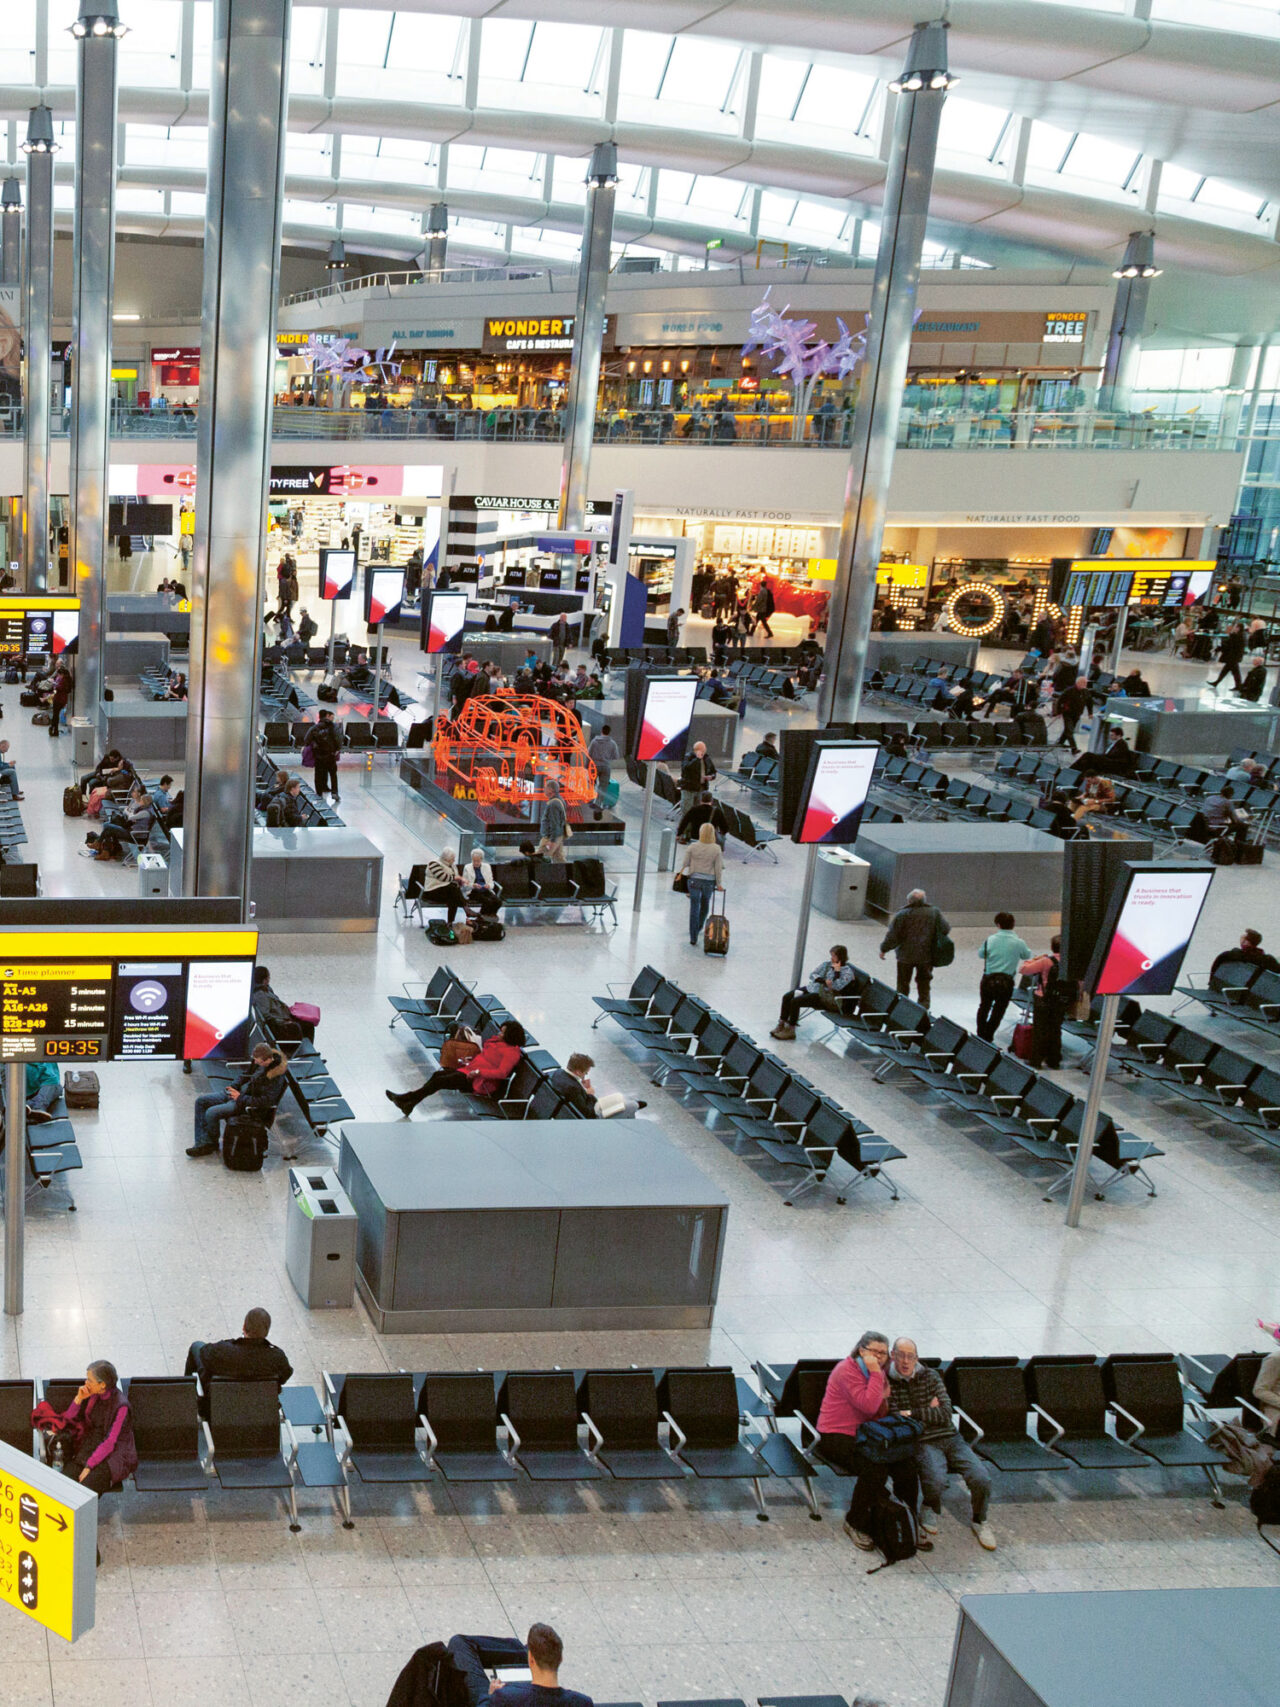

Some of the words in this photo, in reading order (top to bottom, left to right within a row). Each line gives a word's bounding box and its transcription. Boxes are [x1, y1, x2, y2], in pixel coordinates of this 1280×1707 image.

[1047, 312, 1087, 321] WONDER
[489, 318, 609, 337] WONDERTE
[1045, 322, 1084, 335] TREE
[474, 496, 509, 508] CAVIAR
[510, 498, 543, 510] HOUSE
[543, 499, 552, 510] &
[676, 508, 732, 518] NATURALLY
[736, 510, 759, 519] FAST
[762, 511, 793, 520] FOOD
[966, 514, 1023, 523] NATURALLY
[1025, 514, 1048, 522] FAST
[1052, 514, 1081, 523] FOOD
[463, 567, 476, 575] ATM
[509, 570, 522, 579] ATM
[544, 573, 558, 581] ATM
[887, 582, 1084, 643] EON
[40, 969, 75, 977] planner
[3, 987, 37, 995] A1-A5
[71, 986, 78, 995] 5
[3, 1003, 48, 1012] A16-A26
[70, 1003, 77, 1012] 5
[3, 1020, 46, 1028] B28-B49
[64, 1019, 77, 1028] 15
[46, 1040, 100, 1056] 09:35
